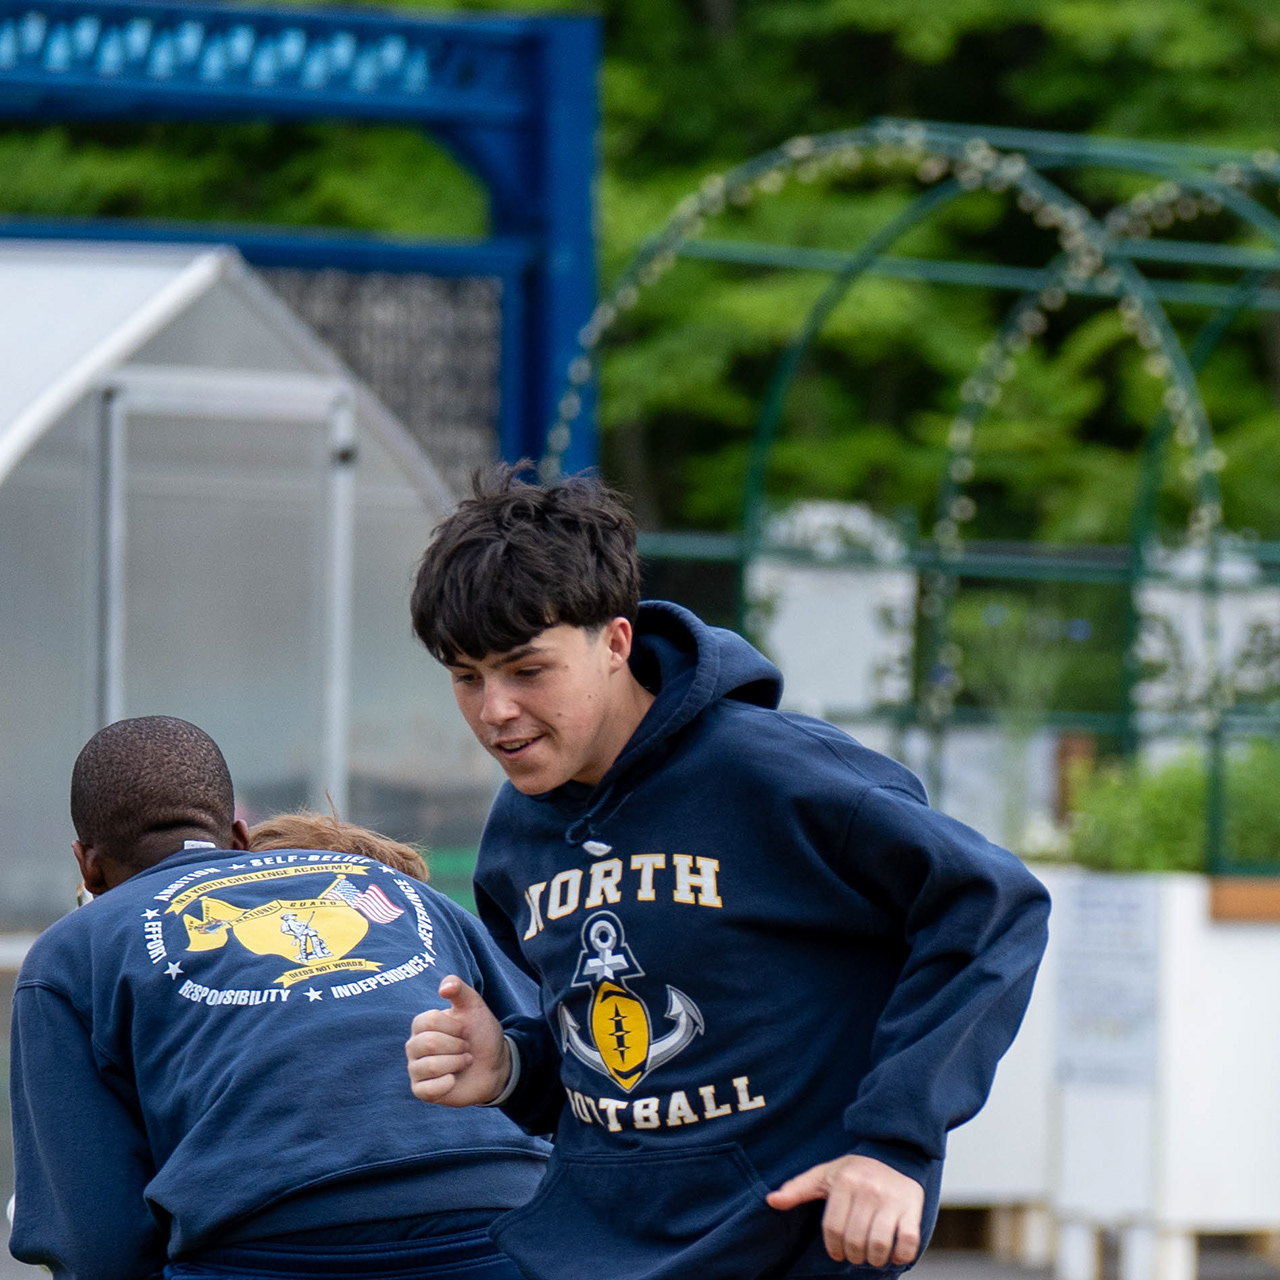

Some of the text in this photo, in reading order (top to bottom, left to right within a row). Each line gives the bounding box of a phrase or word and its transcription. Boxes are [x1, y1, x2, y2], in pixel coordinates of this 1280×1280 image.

[249, 854, 373, 867] SELF-BELIEF
[154, 867, 221, 901] AMBITION
[190, 881, 226, 894] YOUTH
[227, 868, 289, 884] CHALLENGE
[293, 864, 351, 873] ACADEMY
[235, 904, 278, 923] NATIONAL
[523, 853, 723, 941] NORTH
[393, 878, 437, 956] SEVERANCE
[144, 921, 167, 964] EFFORT
[289, 960, 364, 979] DEEDS NOT WORDS
[331, 955, 430, 998] INDEPENDENCE
